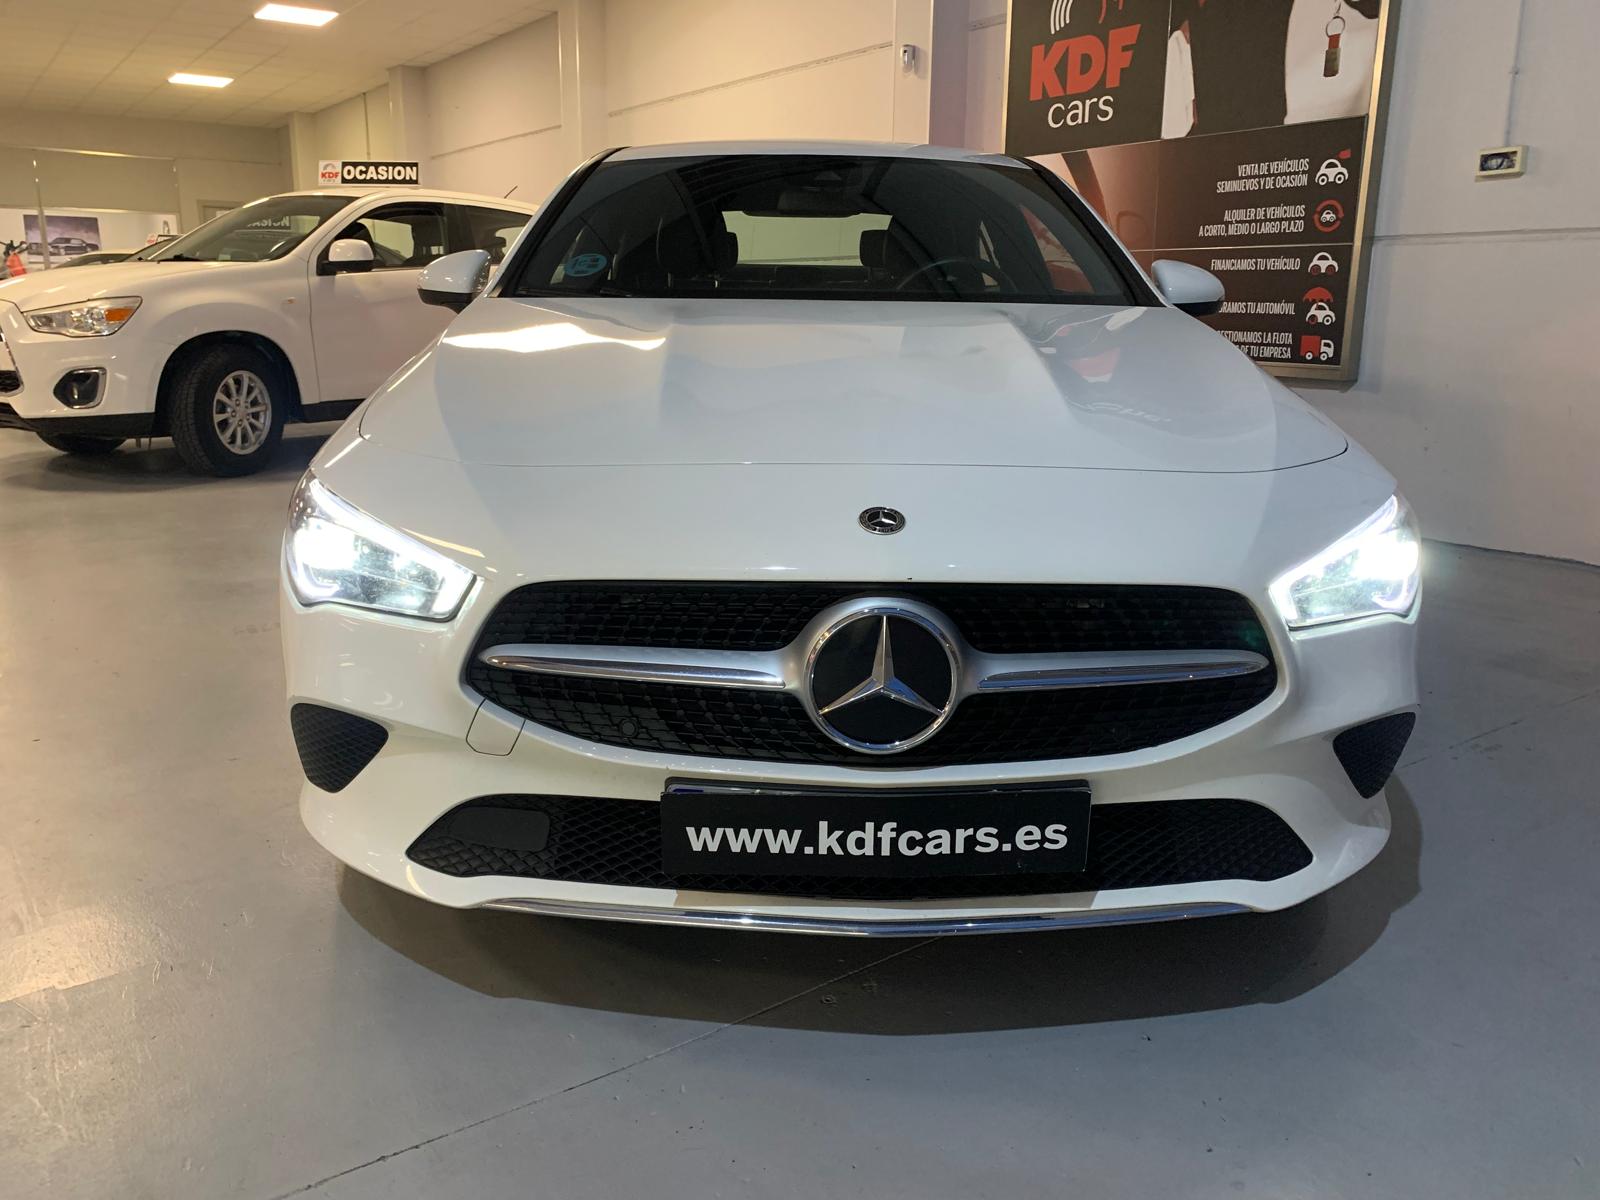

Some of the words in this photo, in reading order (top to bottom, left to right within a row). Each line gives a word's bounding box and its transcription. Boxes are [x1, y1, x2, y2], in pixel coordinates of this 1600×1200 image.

[1029, 24, 1141, 101] KDF
[1047, 95, 1114, 128] cars
[321, 171, 340, 179] KDF
[343, 165, 417, 180] OCASION
[1238, 163, 1258, 176] VENTA
[1260, 162, 1269, 174] DE
[1270, 158, 1309, 173] VEHÍCULOS
[1217, 179, 1259, 193] SEMINUEVOS
[1260, 178, 1265, 189] Y
[1265, 177, 1275, 189] DE
[1276, 172, 1308, 188] OCASIÓN
[1224, 208, 1255, 224] ALQUILER
[1256, 208, 1265, 219] DE
[1267, 204, 1305, 219] VEHÍCULOS
[1199, 226, 1203, 237] A
[1204, 224, 1227, 236] CORTO,
[1228, 223, 1249, 235] MEDIO
[1250, 223, 1256, 234] O
[1257, 221, 1280, 234] LARGO
[1281, 220, 1304, 232] PLAZO
[1211, 259, 1256, 270] FINANCIAMOS
[1257, 259, 1266, 270] TU
[1267, 256, 1300, 270] VEHÍCULO
[1247, 302, 1256, 313] TU
[1256, 300, 1295, 314] AUTOMÓVIL
[1263, 332, 1271, 343] LA
[1273, 333, 1292, 344] FLOTA
[1250, 346, 1259, 356] TU
[1260, 346, 1291, 358] EMPRESA
[686, 820, 1069, 856] www.kdfcars.es
